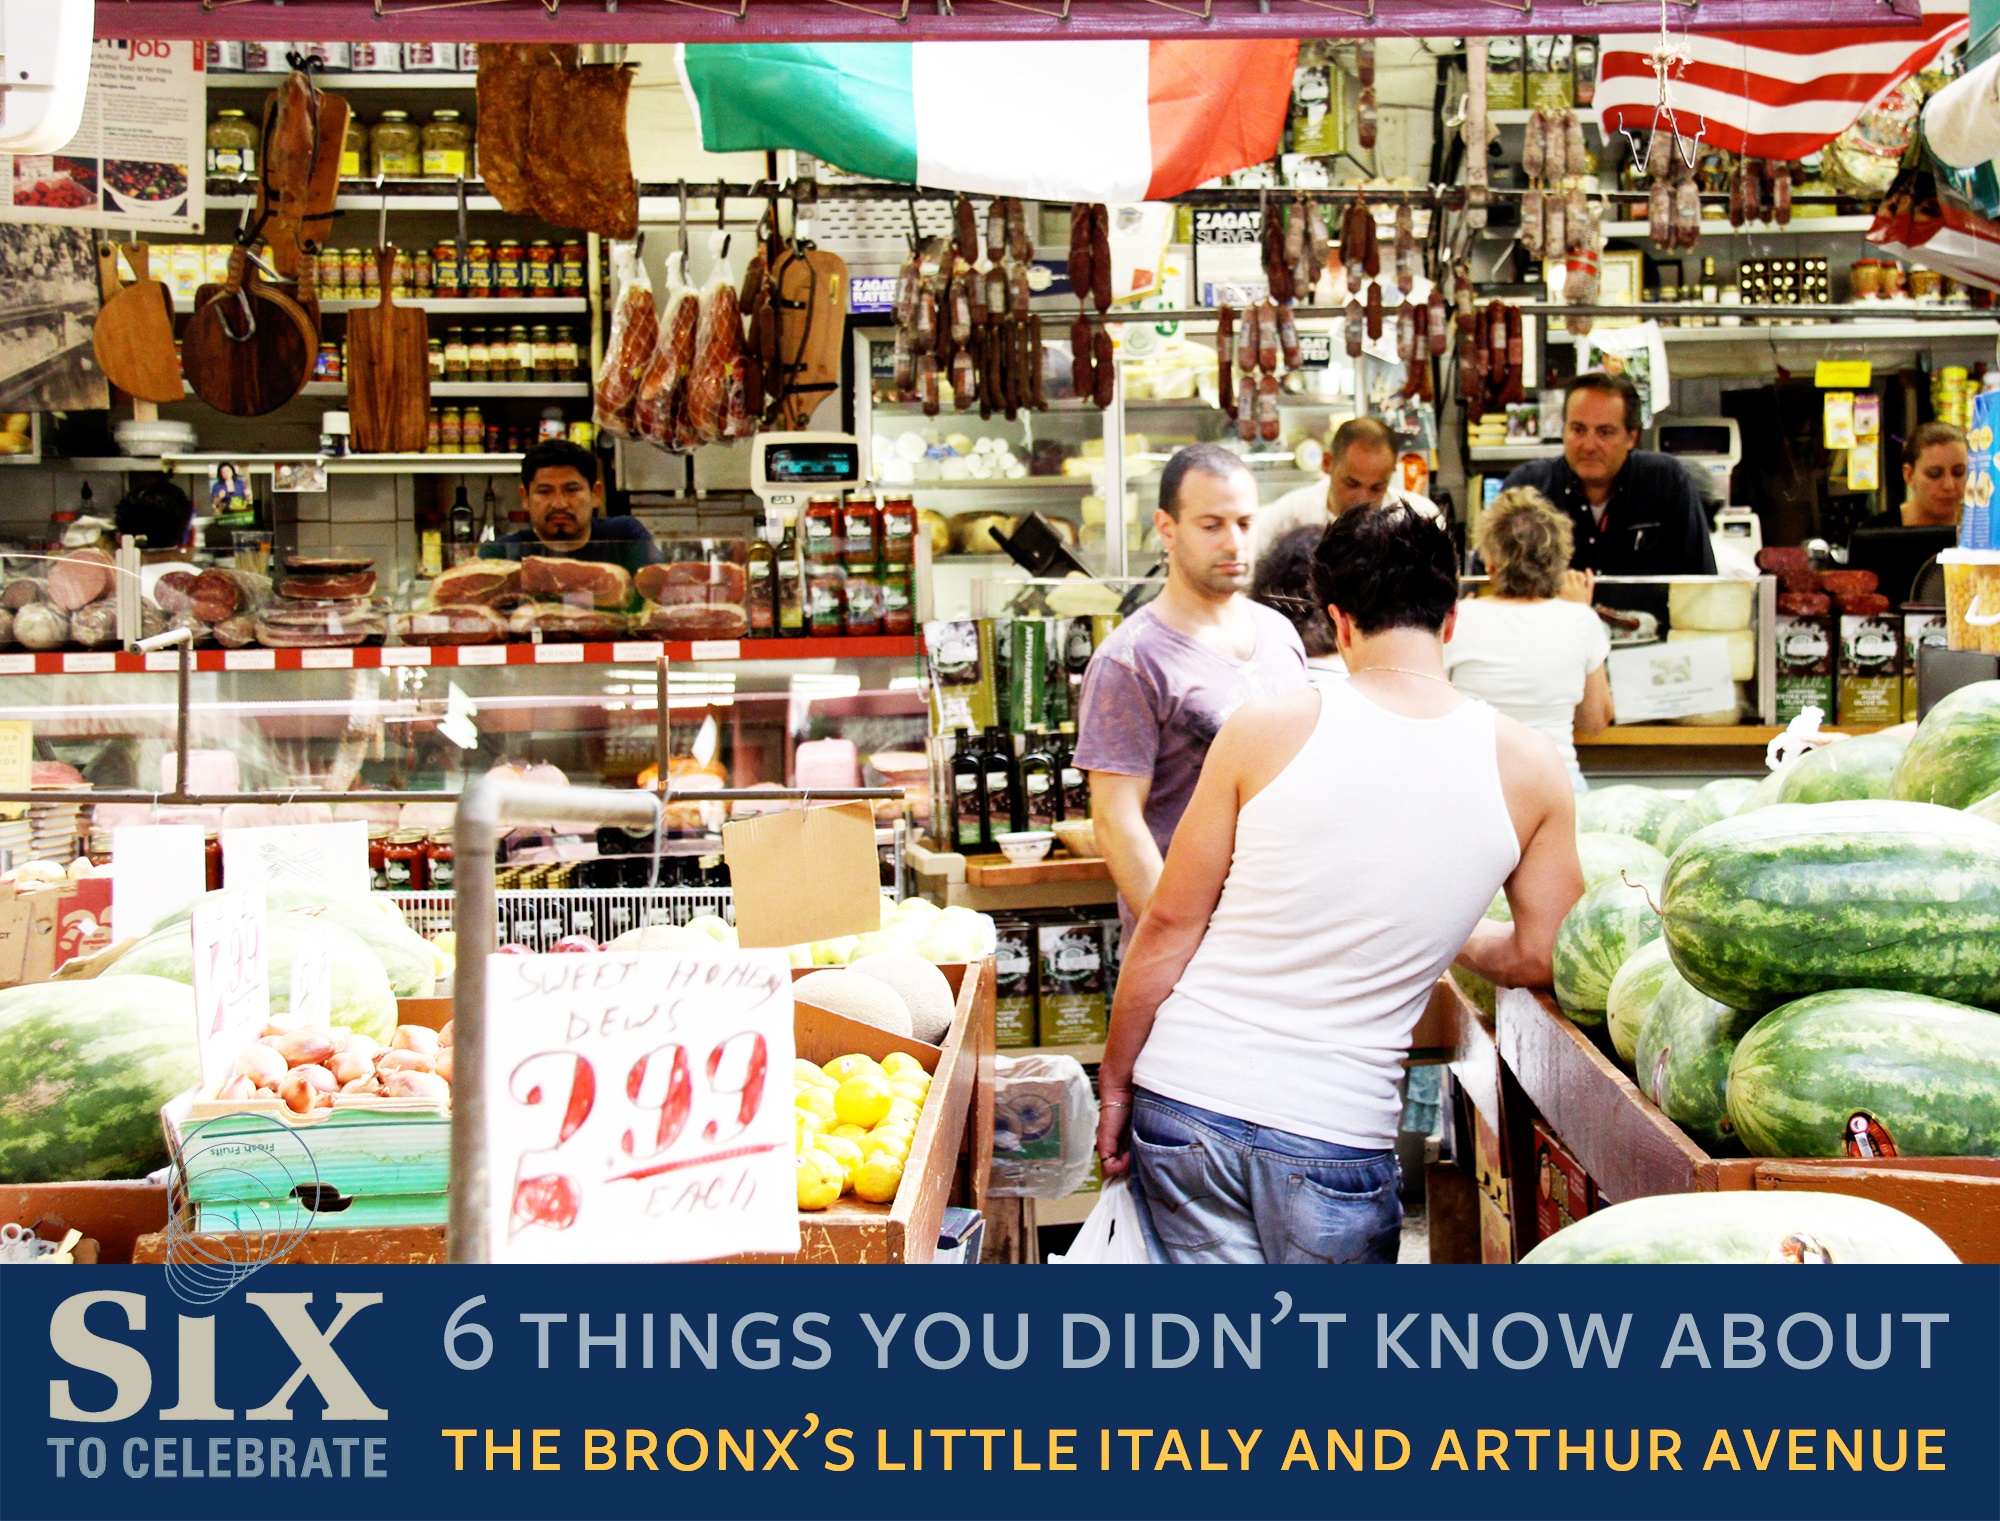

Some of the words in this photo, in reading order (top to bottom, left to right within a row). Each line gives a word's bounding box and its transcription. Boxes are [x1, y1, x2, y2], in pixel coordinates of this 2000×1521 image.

[128, 38, 171, 61] job
[1196, 211, 1262, 230] ZAGAT
[1196, 230, 1262, 244] SURVEY
[852, 279, 897, 291] ZAGAT
[514, 960, 640, 1001] SWEET
[666, 959, 786, 1011] HONEY
[566, 999, 684, 1043] DEWS
[508, 1029, 770, 1245] 2.99
[210, 1146, 240, 1156] Fruits
[244, 1143, 275, 1153] Fresh
[644, 1168, 758, 1218] EACH
